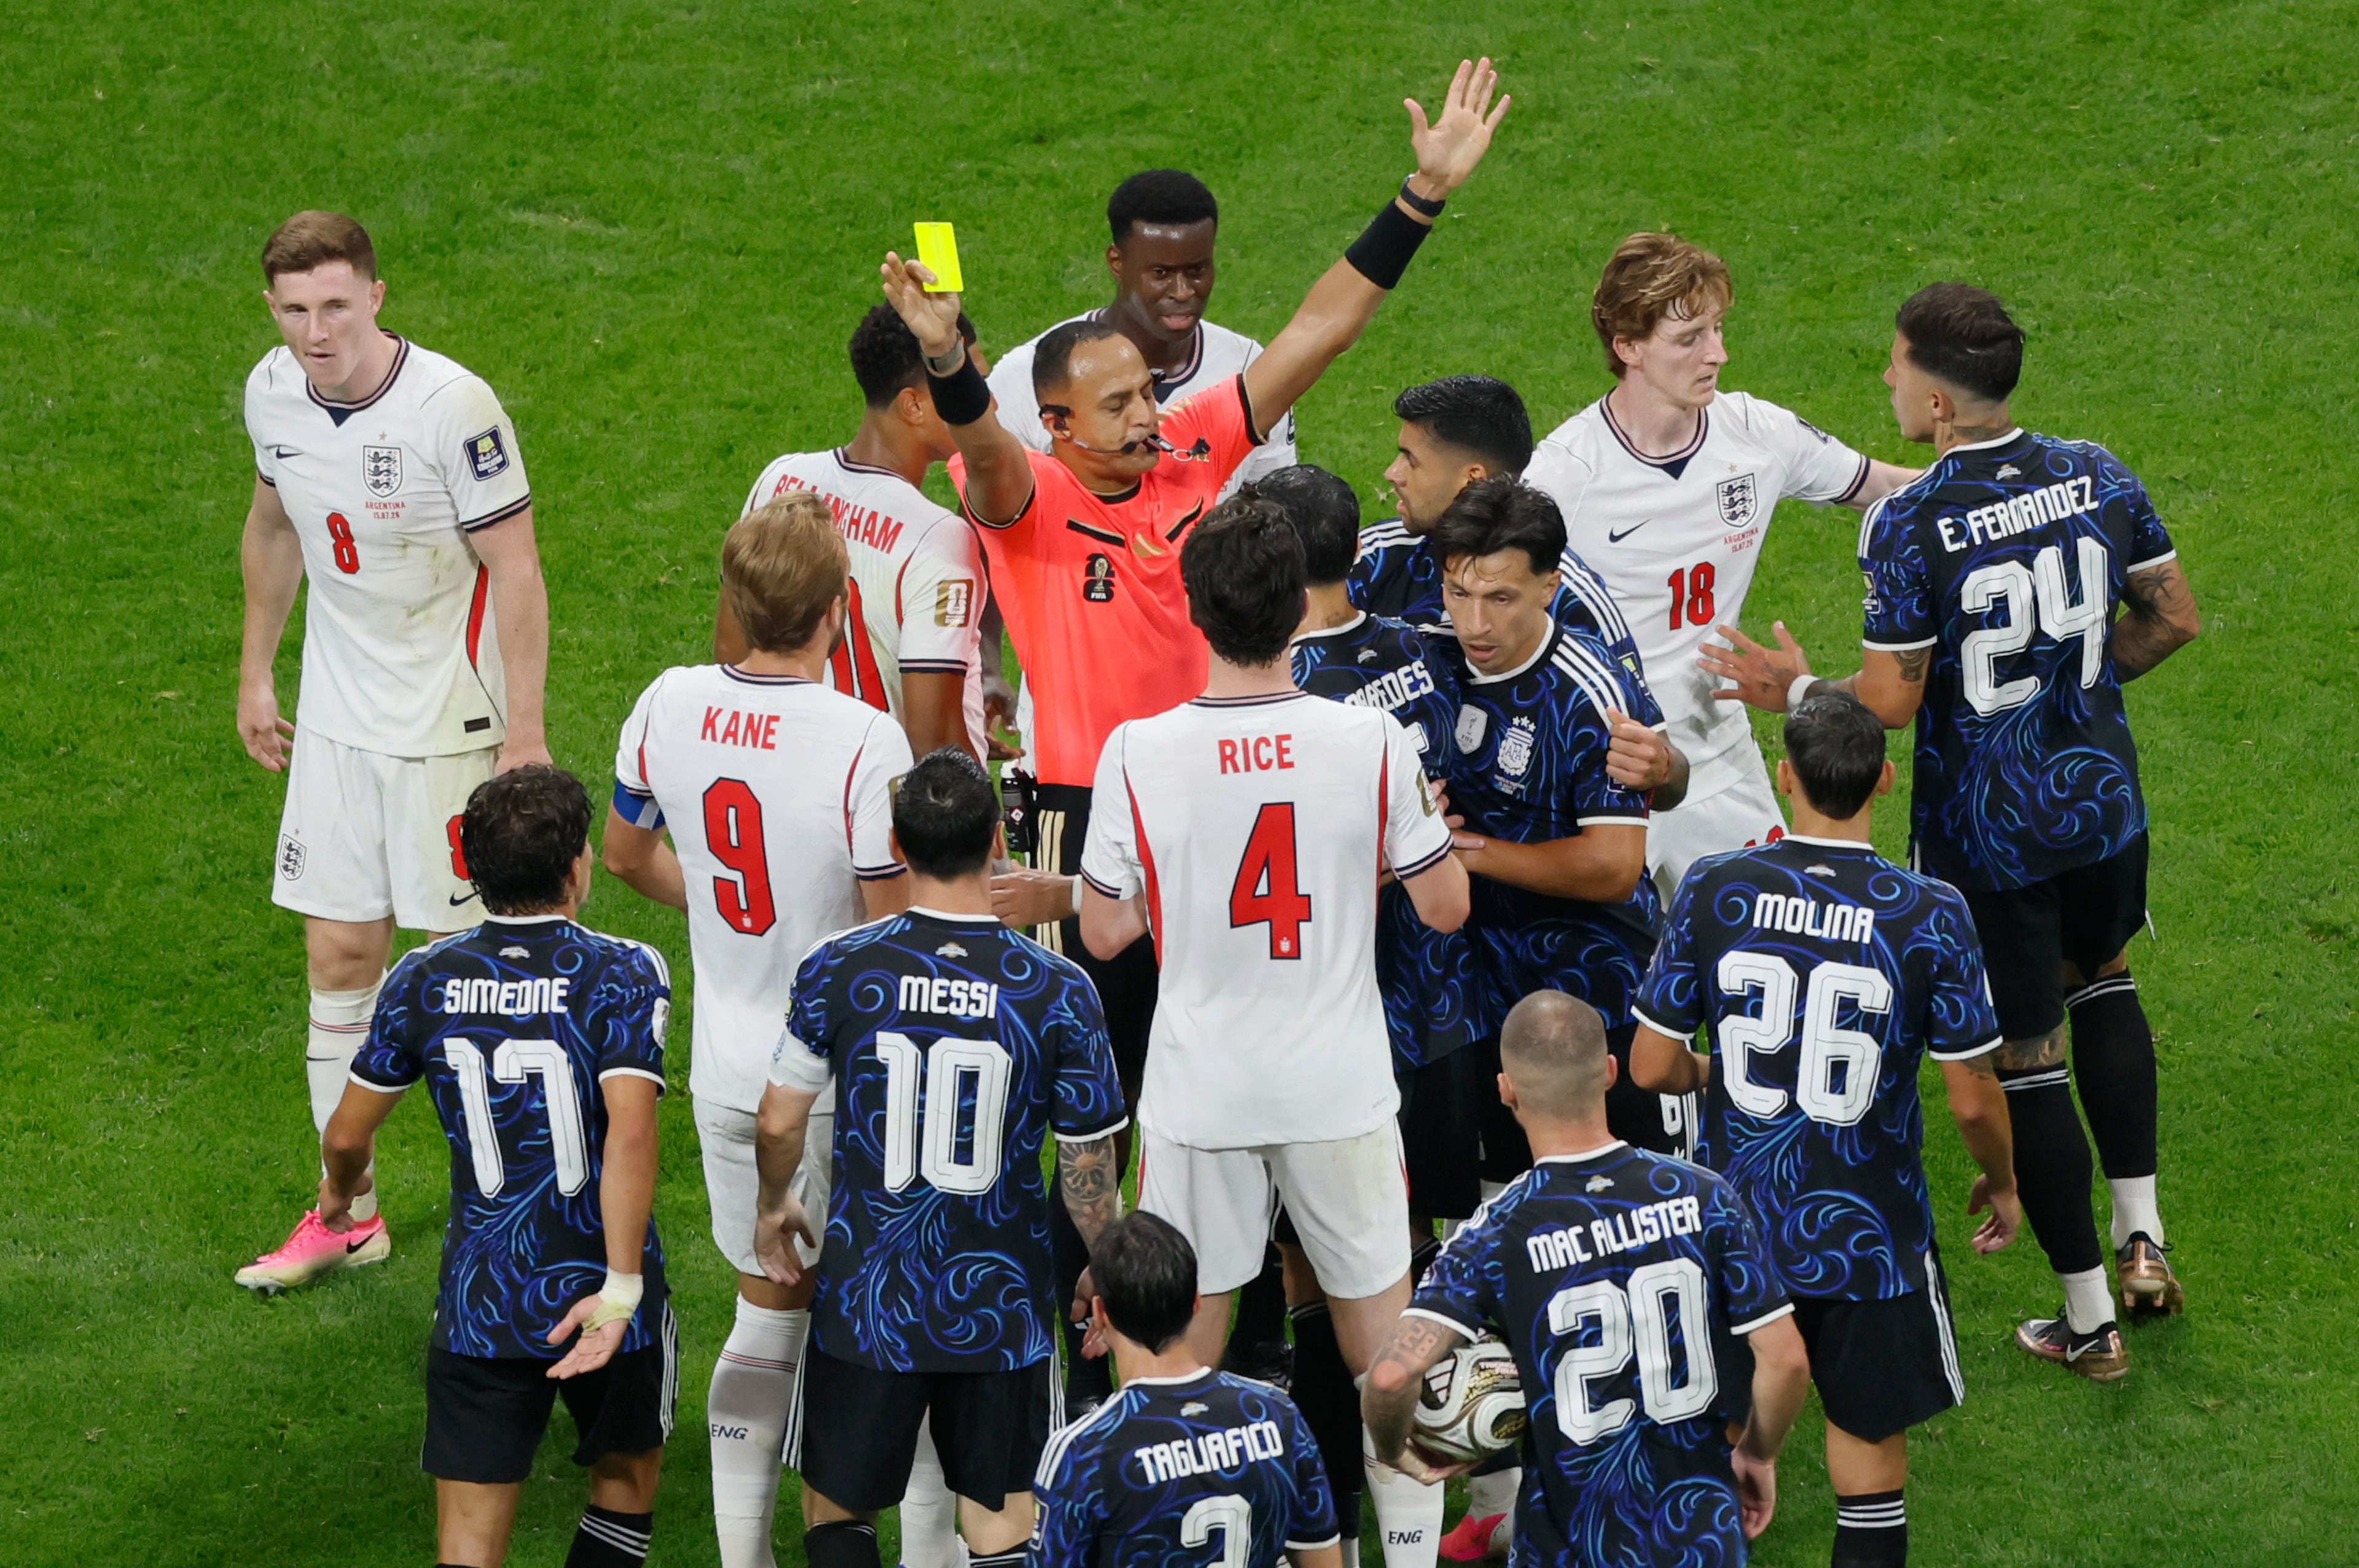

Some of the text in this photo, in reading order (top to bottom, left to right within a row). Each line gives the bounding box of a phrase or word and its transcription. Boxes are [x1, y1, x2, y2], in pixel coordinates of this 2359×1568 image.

[327, 512, 360, 574] 8
[773, 474, 904, 554] BNGHAM
[1724, 527, 1758, 545] ARGENTINA
[1668, 561, 1715, 631] 18
[1961, 536, 2108, 717] 24
[701, 706, 781, 751] KANE
[1218, 733, 1295, 775] RICE
[1505, 741, 1522, 762] AFA
[703, 777, 776, 937] 9
[1229, 802, 1312, 960] 4
[1752, 892, 1875, 945] MOLINA
[444, 977, 571, 1015] SIMEONE
[899, 975, 999, 1019] MESSI
[1718, 950, 1894, 1127] 26
[443, 1037, 590, 1198] 17
[876, 1031, 1013, 1195] 10
[1526, 1195, 1702, 1274] MAC ALLISTER
[1547, 1257, 1719, 1446] 20
[711, 1423, 749, 1441] ENG
[1134, 1420, 1284, 1484] TAGLIAFICO
[1388, 1529, 1423, 1545] ENG
